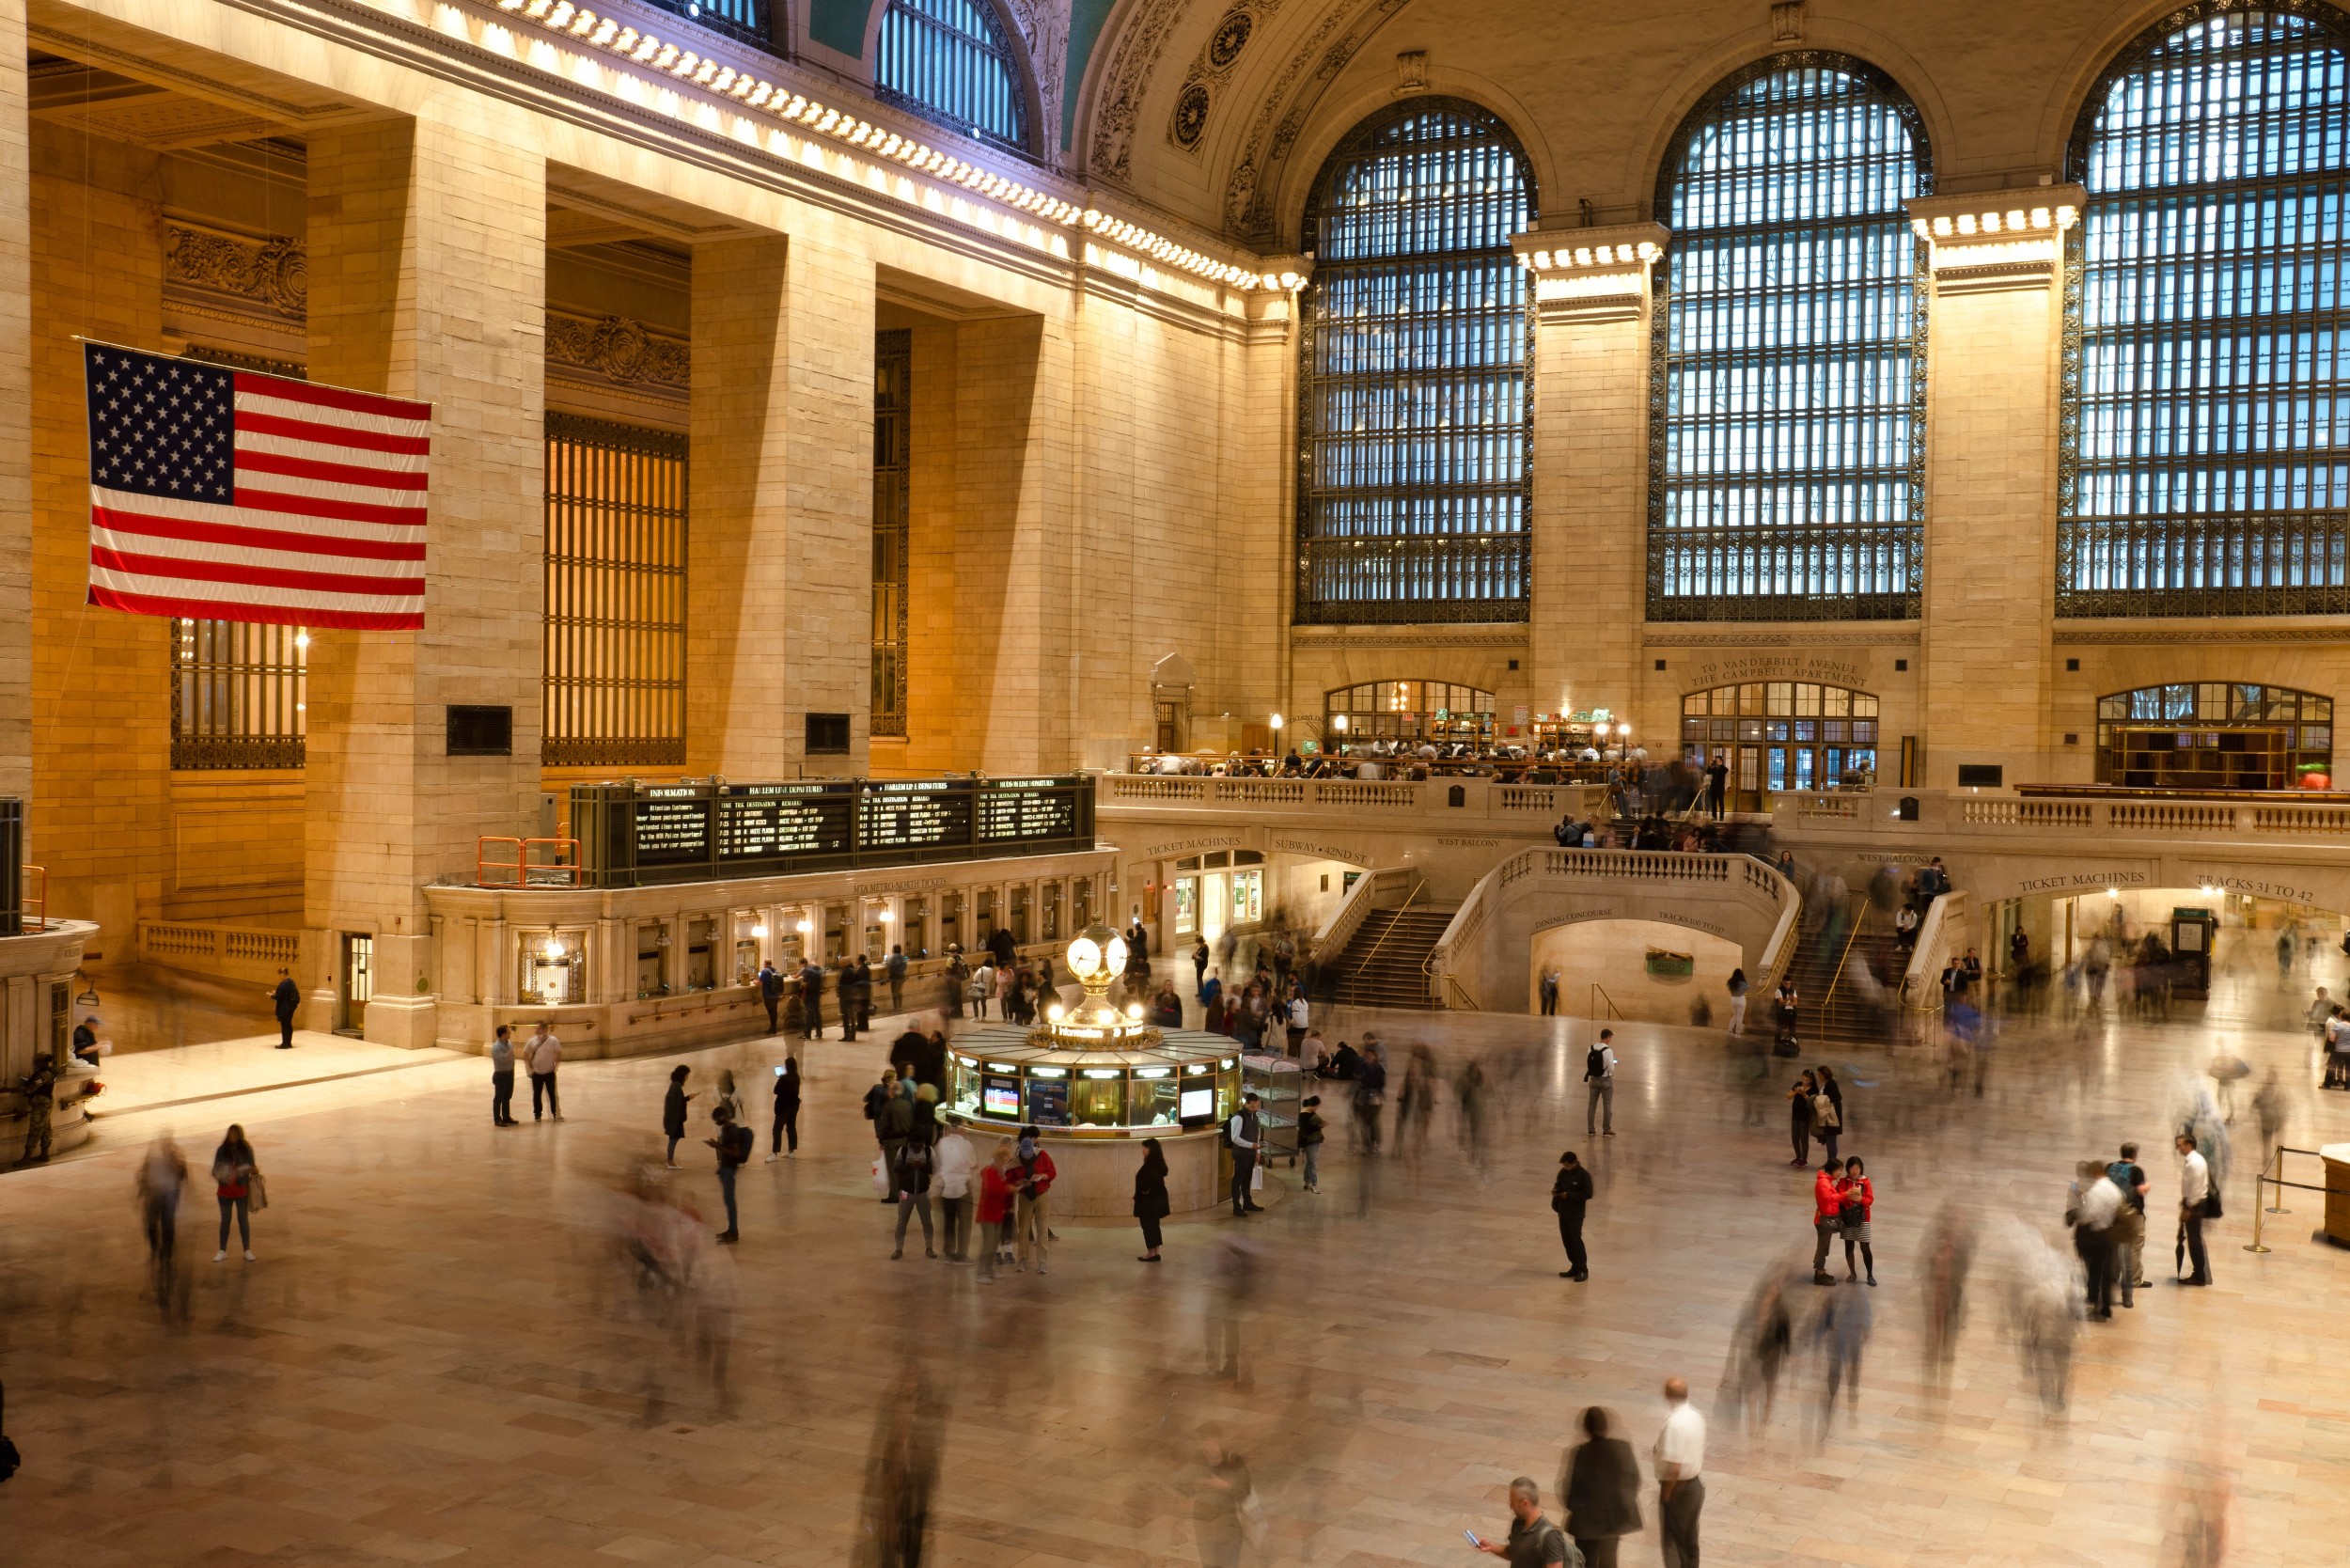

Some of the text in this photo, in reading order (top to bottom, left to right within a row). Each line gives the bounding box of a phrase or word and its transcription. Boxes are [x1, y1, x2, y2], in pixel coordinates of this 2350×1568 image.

[1700, 657, 1858, 674] TO VANDERBILT AVENUE
[1691, 667, 1867, 687] THE CAMPBELL APARTMENT
[650, 789, 696, 798] INFORMATION
[1147, 837, 1241, 855] TICKET MACHINES
[1275, 839, 1367, 864] SUBWAY 42ND ST
[1436, 838, 1500, 848] WEST BALCONY
[1857, 854, 1933, 864] WEST BALCONY
[854, 884, 869, 894] MTA
[920, 876, 948, 888] TICKETS
[2018, 871, 2145, 891] TICKET MACHINES
[2195, 874, 2314, 902] TRACKS 31 TO 42
[1535, 908, 1613, 929] DINING CONCOURSE
[1658, 911, 1725, 933] TRACKS 100 TO 117
[1058, 1026, 1104, 1039] Information
